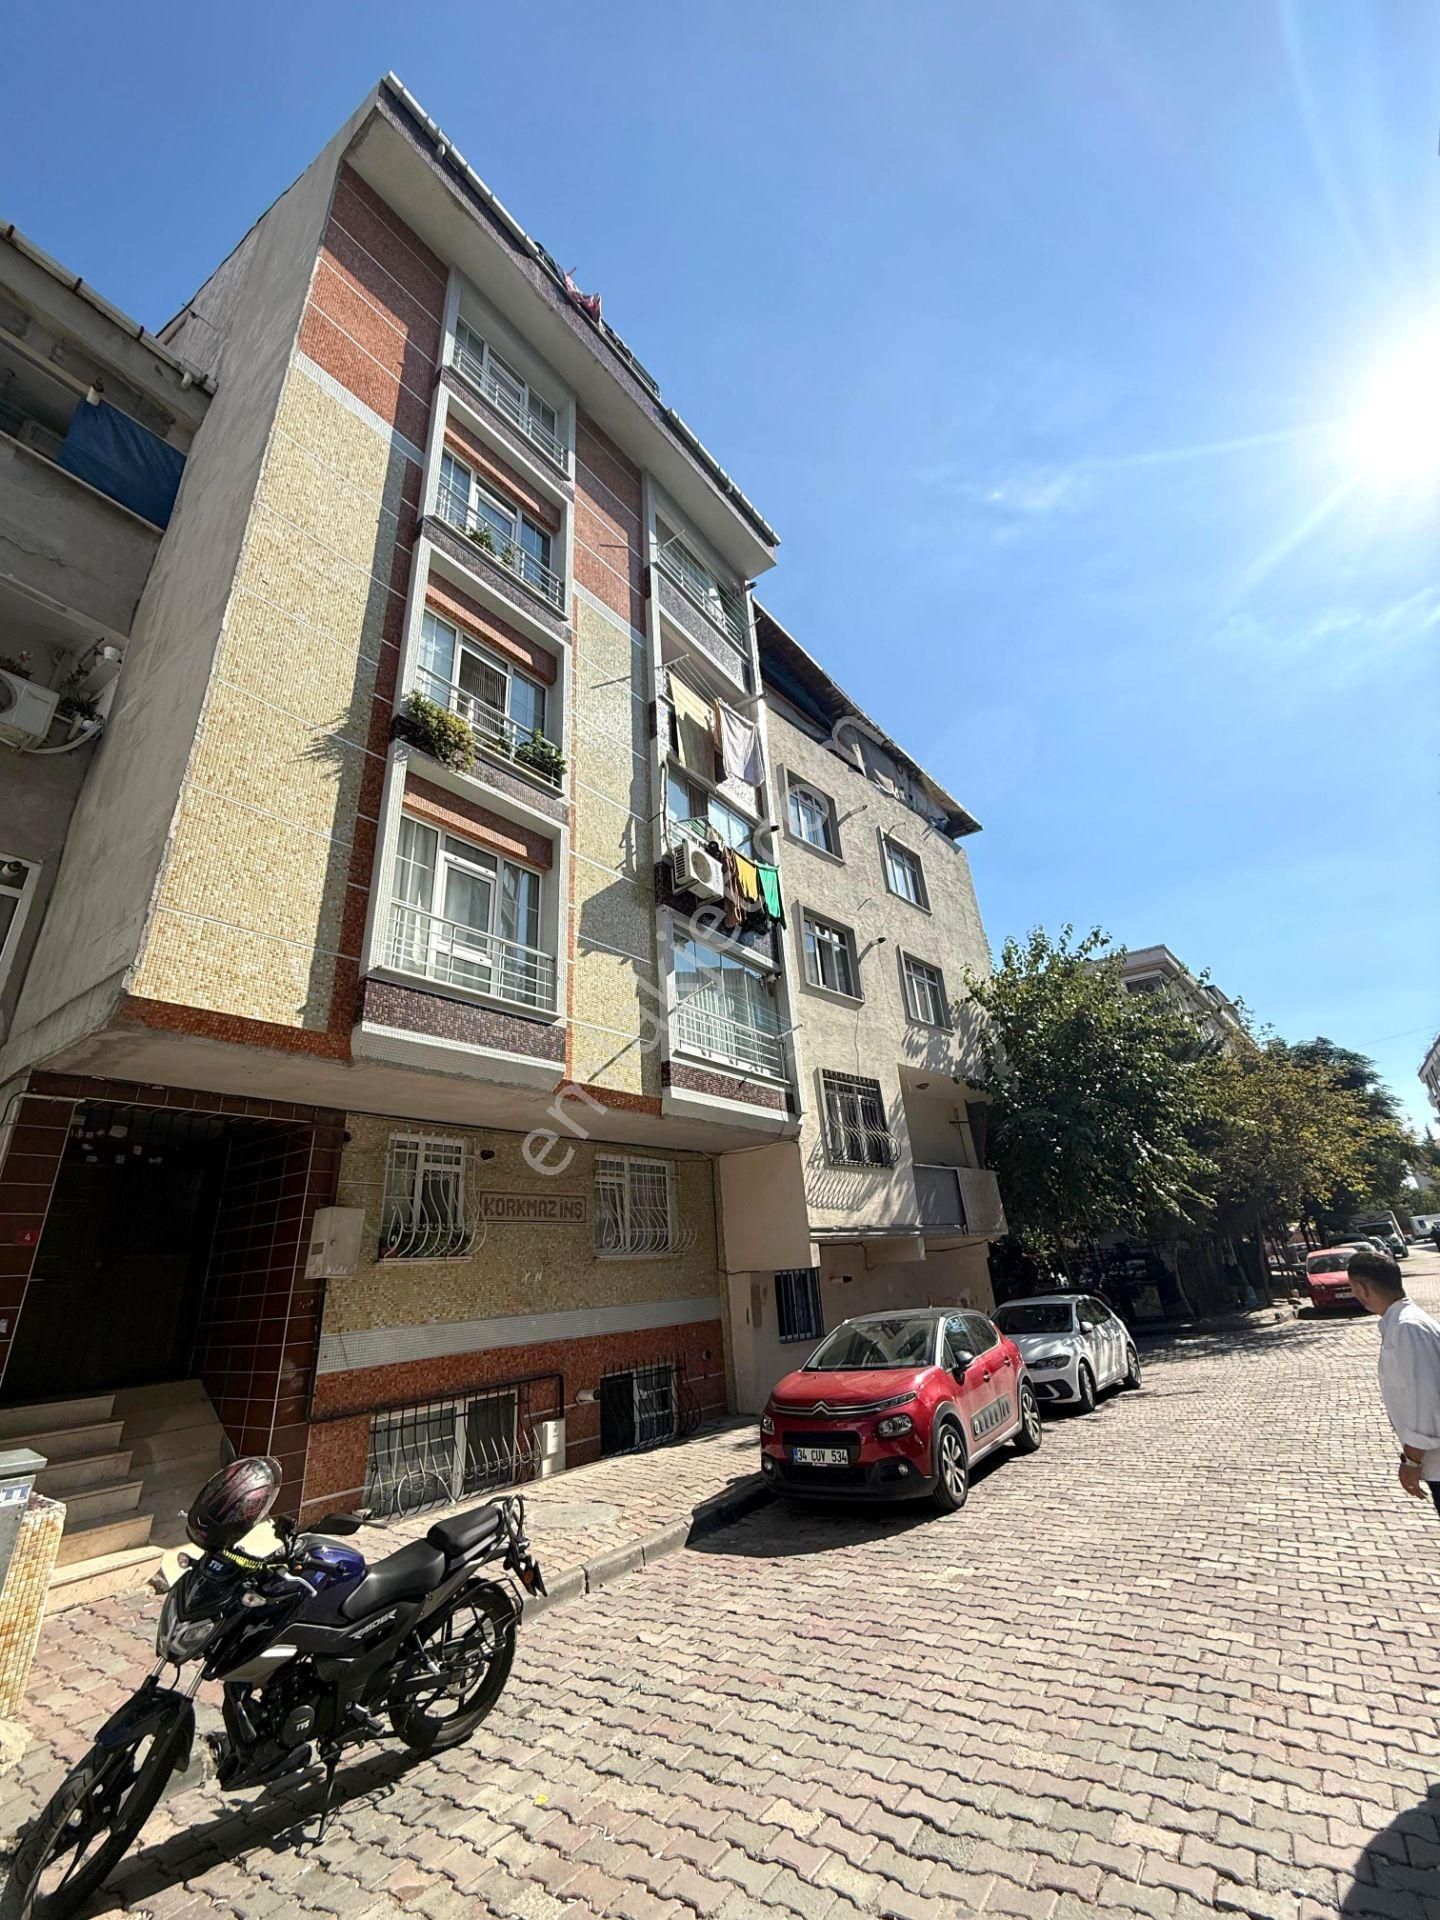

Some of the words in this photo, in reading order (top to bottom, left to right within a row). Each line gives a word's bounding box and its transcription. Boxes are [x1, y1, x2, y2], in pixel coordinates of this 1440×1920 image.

[484, 1197, 557, 1217] KORKMAZ
[24, 1232, 32, 1241] 4
[797, 1449, 807, 1461] 34
[811, 1449, 826, 1462] CUV
[831, 1450, 847, 1463] 534
[208, 1559, 224, 1572] TVS
[295, 1720, 311, 1731] TVS
